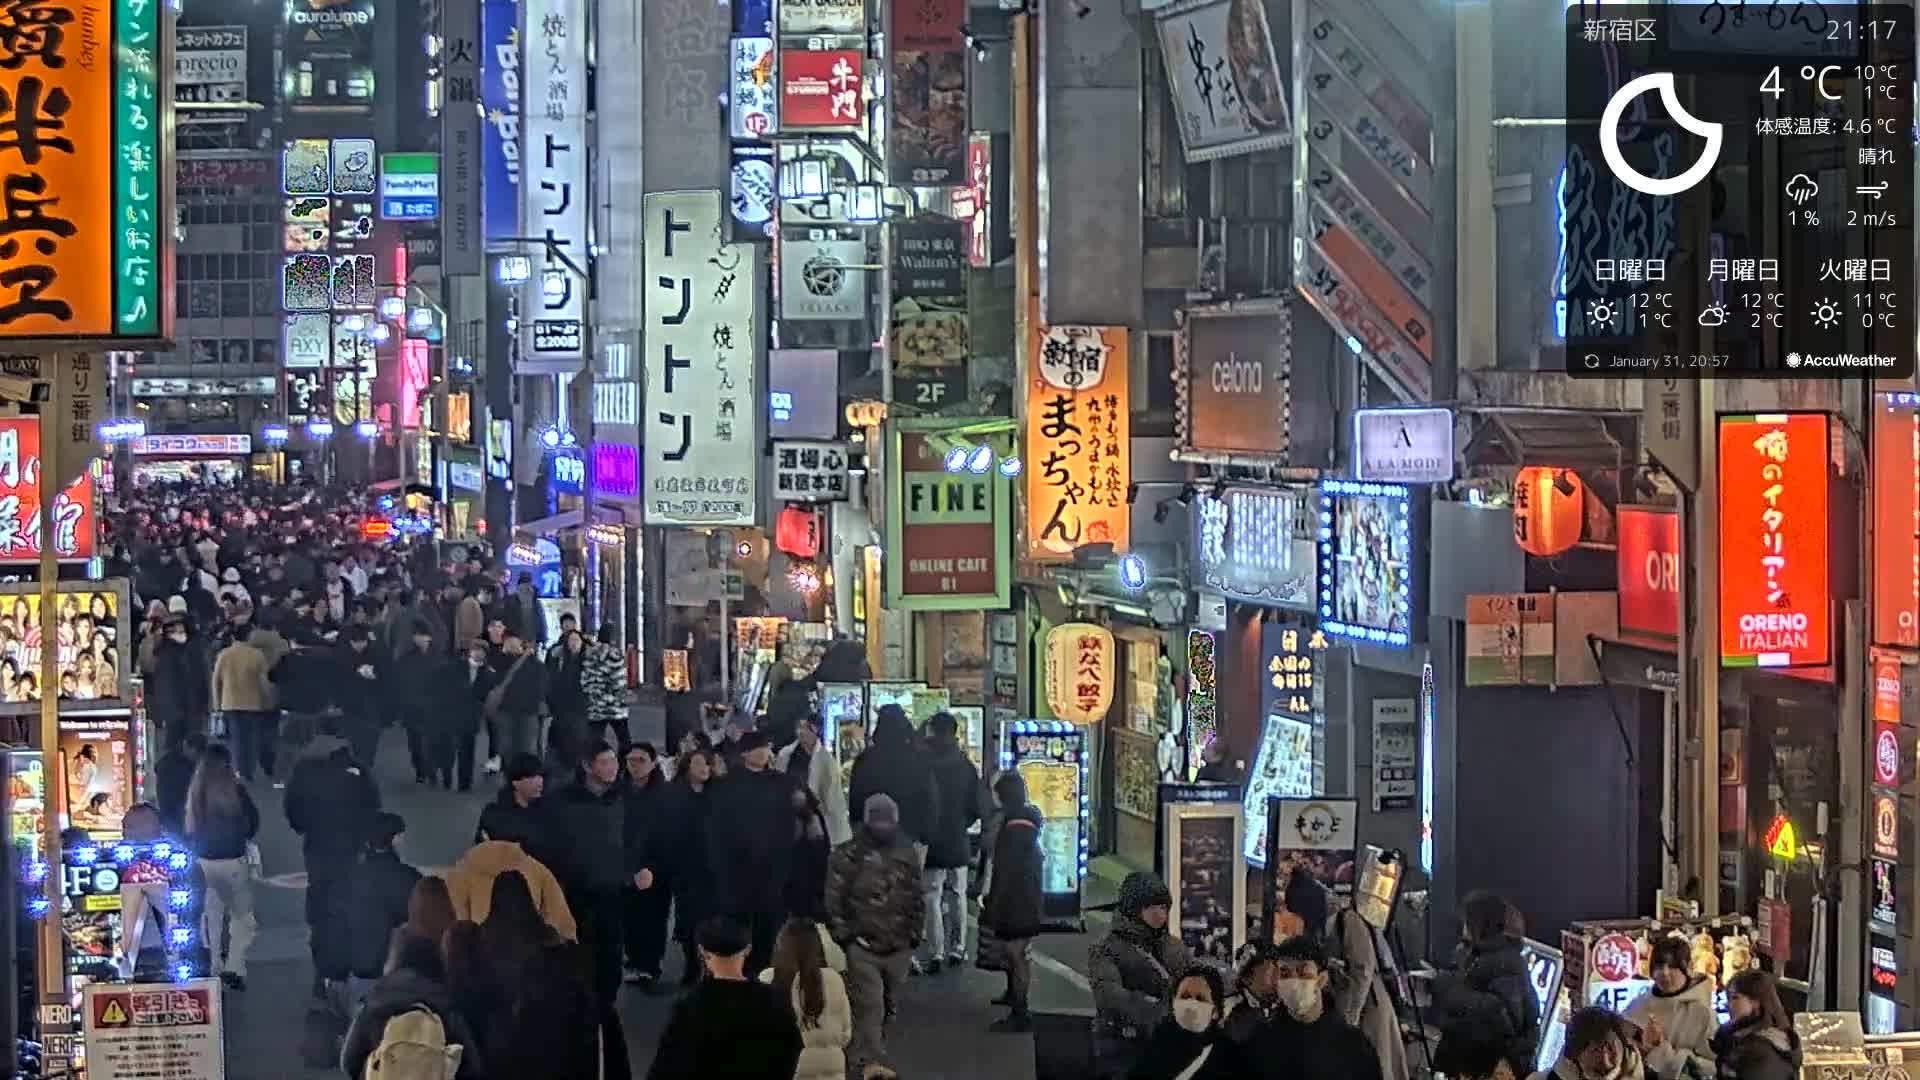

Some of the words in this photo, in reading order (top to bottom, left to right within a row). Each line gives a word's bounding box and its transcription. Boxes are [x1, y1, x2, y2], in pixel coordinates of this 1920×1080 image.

[1314, 120, 1333, 140] 3
[1312, 170, 1333, 189] 2
[658, 206, 691, 462] トントン
[916, 383, 946, 403] 2F
[778, 448, 844, 470] 酒場心
[1040, 393, 1085, 543] まっちゃん
[778, 473, 843, 492] 新宿本店
[911, 483, 986, 512] FINE
[1754, 429, 1788, 603] 俺のイタリアン
[909, 559, 953, 573] ONLINE
[957, 558, 988, 572] CAFE
[1739, 613, 1808, 632] ORENO
[1739, 633, 1809, 650] ITALIAN
[42, 1004, 72, 1025] NERO
